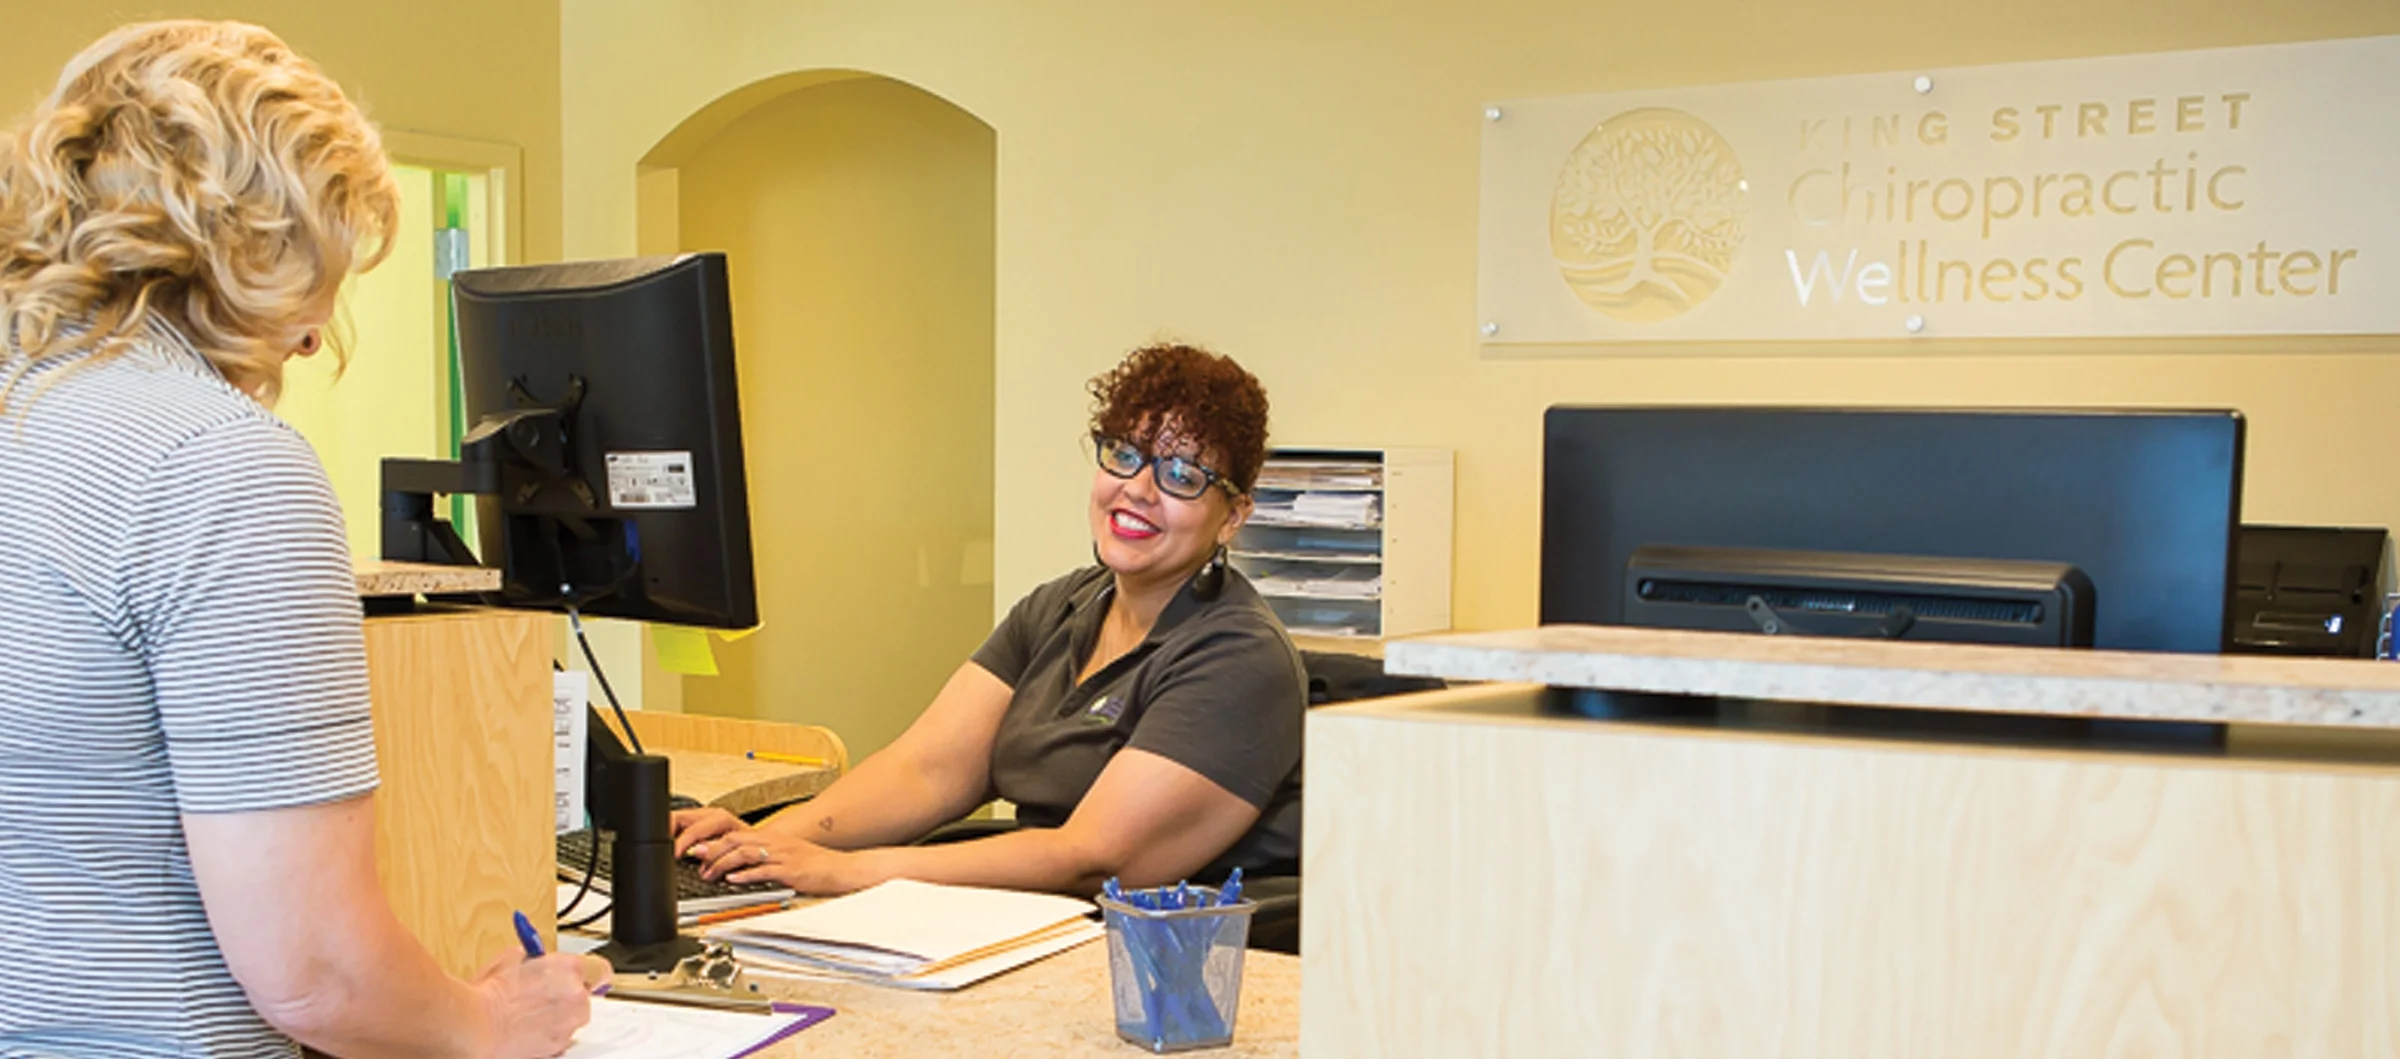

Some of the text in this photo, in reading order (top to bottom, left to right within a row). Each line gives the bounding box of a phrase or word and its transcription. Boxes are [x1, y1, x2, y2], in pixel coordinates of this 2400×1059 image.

[1799, 93, 2250, 151] KING STREET
[1788, 151, 2247, 239] Chiropractic
[1786, 238, 2357, 306] Wellness Center
